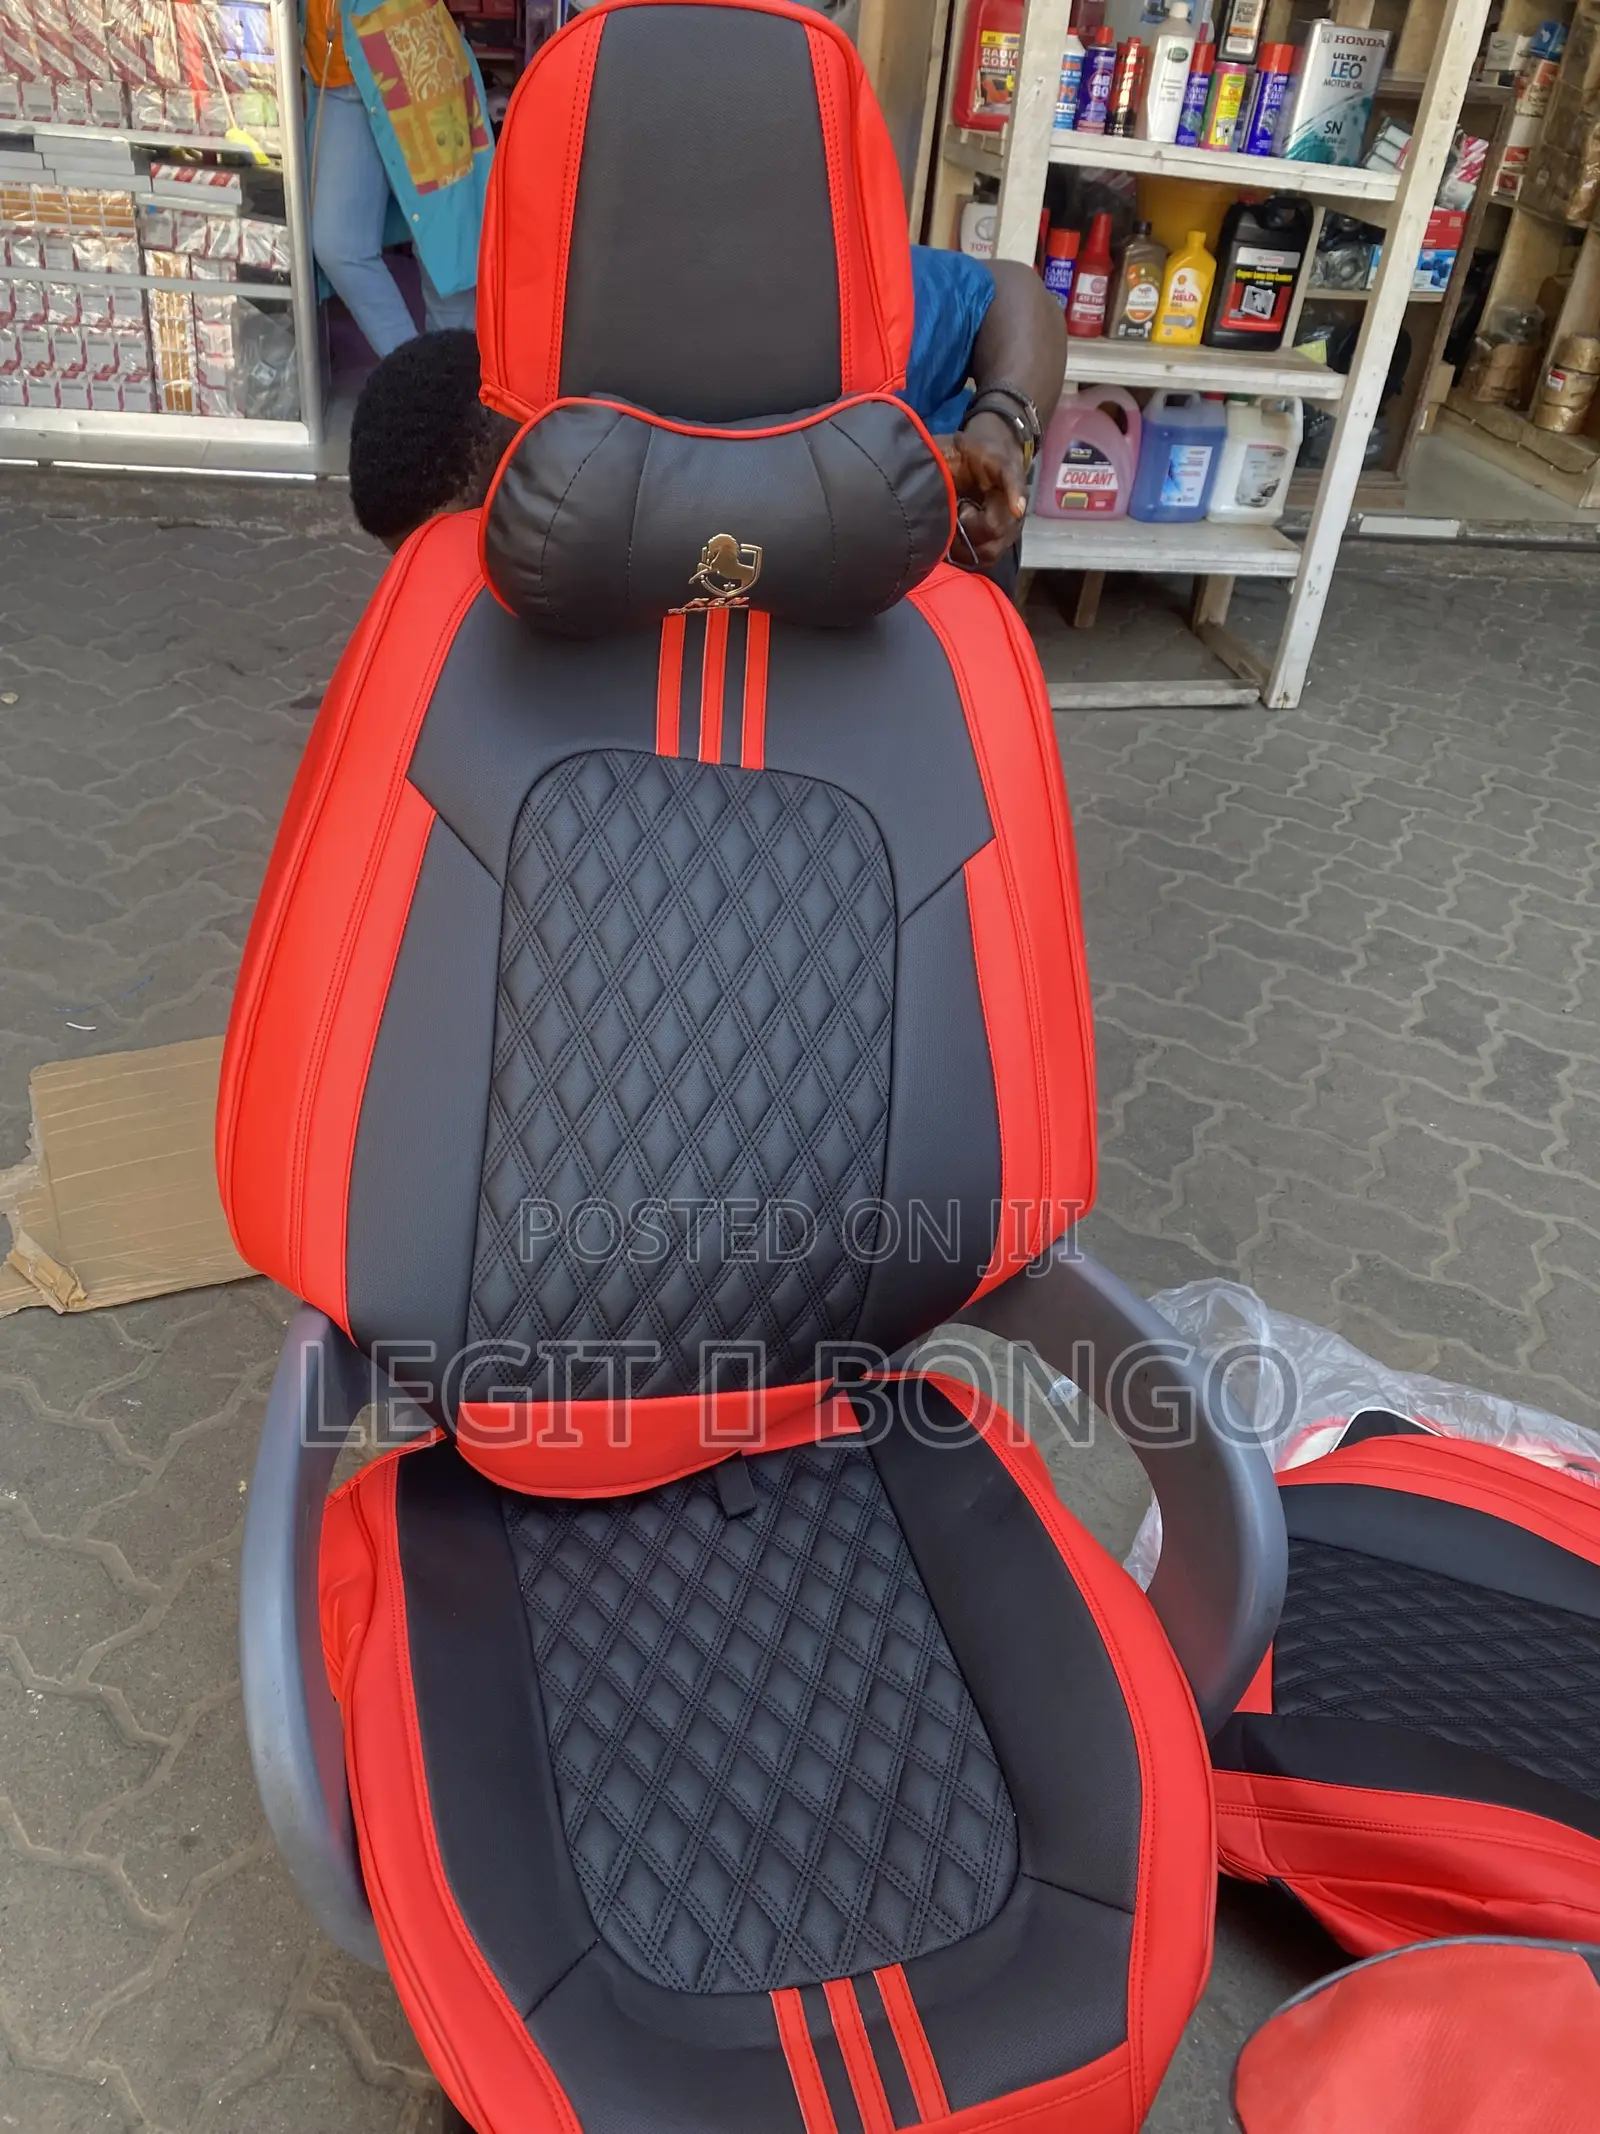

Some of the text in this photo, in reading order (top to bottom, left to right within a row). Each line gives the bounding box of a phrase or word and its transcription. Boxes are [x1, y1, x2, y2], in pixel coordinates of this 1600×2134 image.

[1334, 34, 1386, 48] HONDA
[982, 57, 1016, 68] COOL
[1333, 52, 1367, 62] ULTRA
[1330, 60, 1363, 79] LEO
[1323, 79, 1363, 90] MOTOR OIL
[1324, 120, 1343, 134] SN
[1172, 292, 1198, 302] HELIX
[1063, 471, 1115, 486] COOLANT
